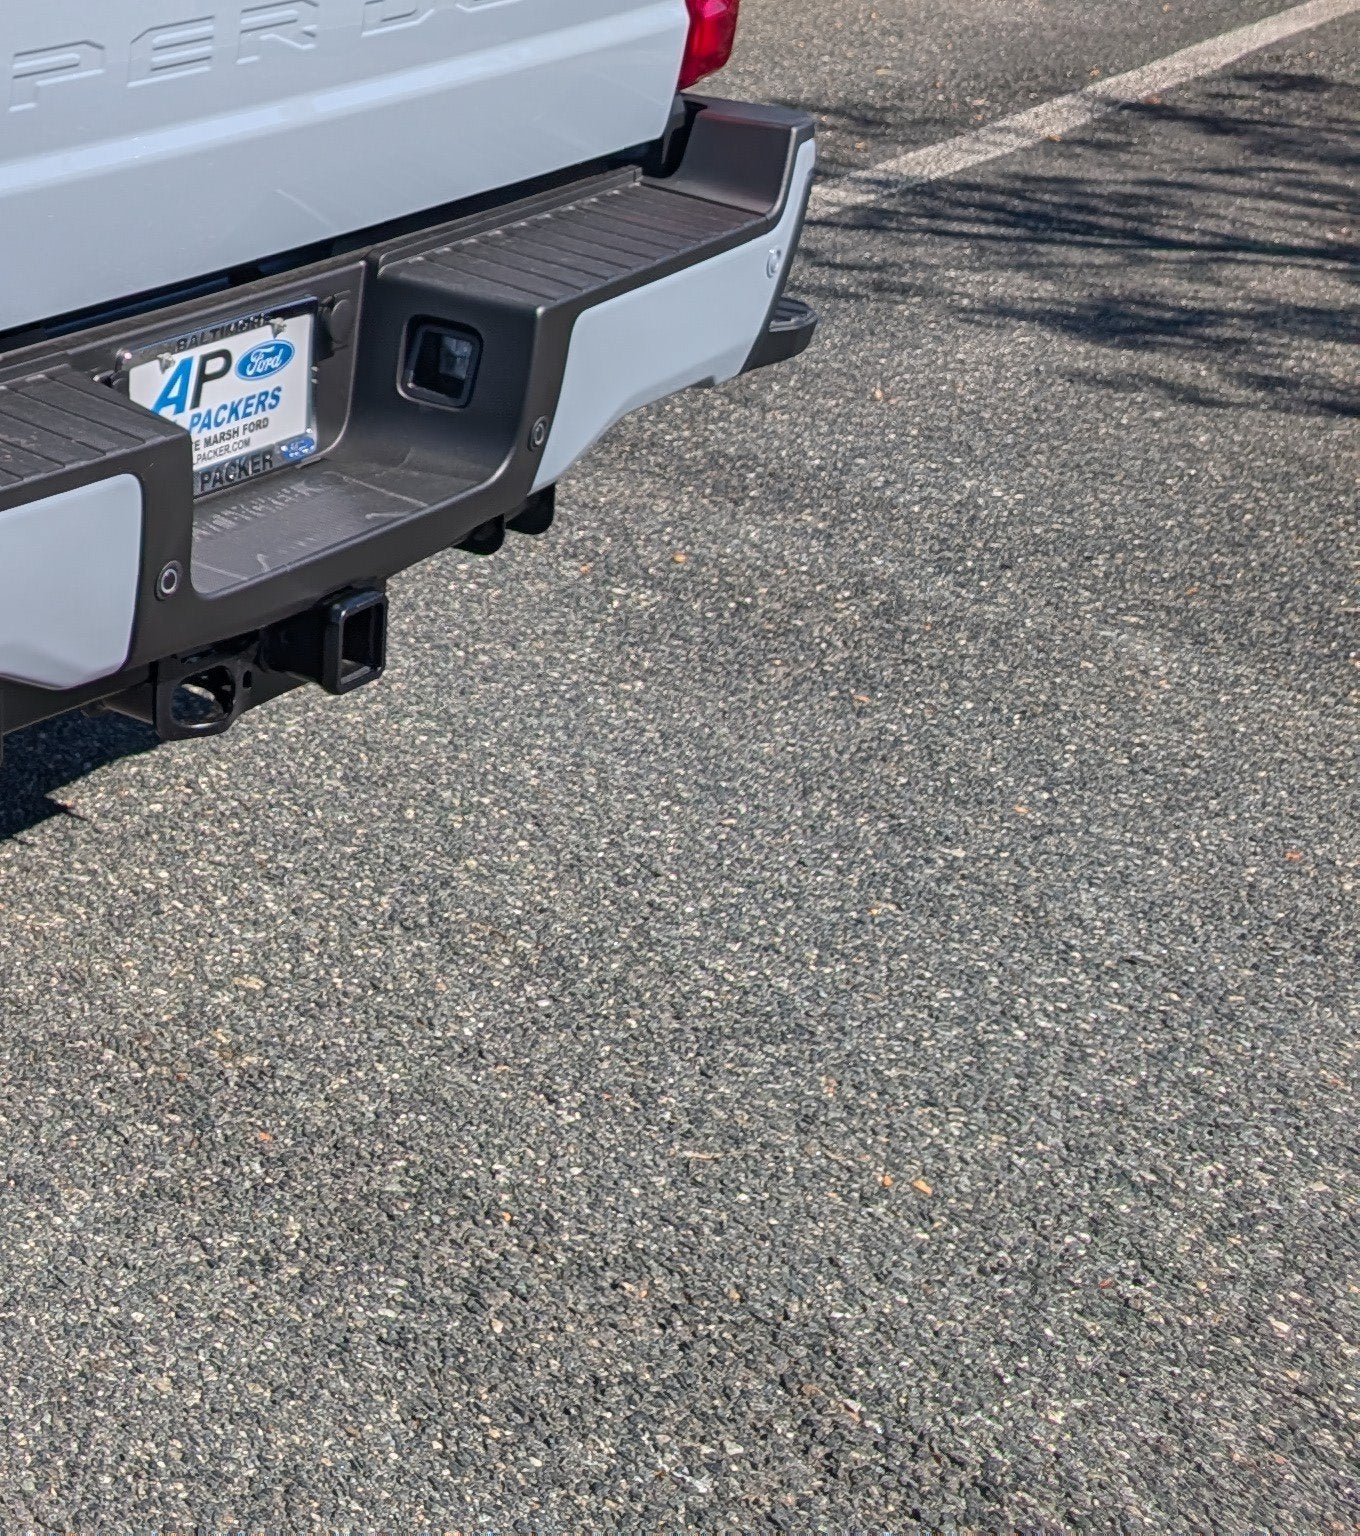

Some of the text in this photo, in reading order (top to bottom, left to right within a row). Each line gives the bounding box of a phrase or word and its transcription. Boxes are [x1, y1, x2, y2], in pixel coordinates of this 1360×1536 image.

[246, 346, 284, 376] Ford
[189, 385, 282, 434] PACKERS
[203, 425, 240, 448] MARSH
[242, 417, 269, 436] FORD
[193, 437, 251, 465] PACKER.COM
[199, 450, 273, 492] PACKER
